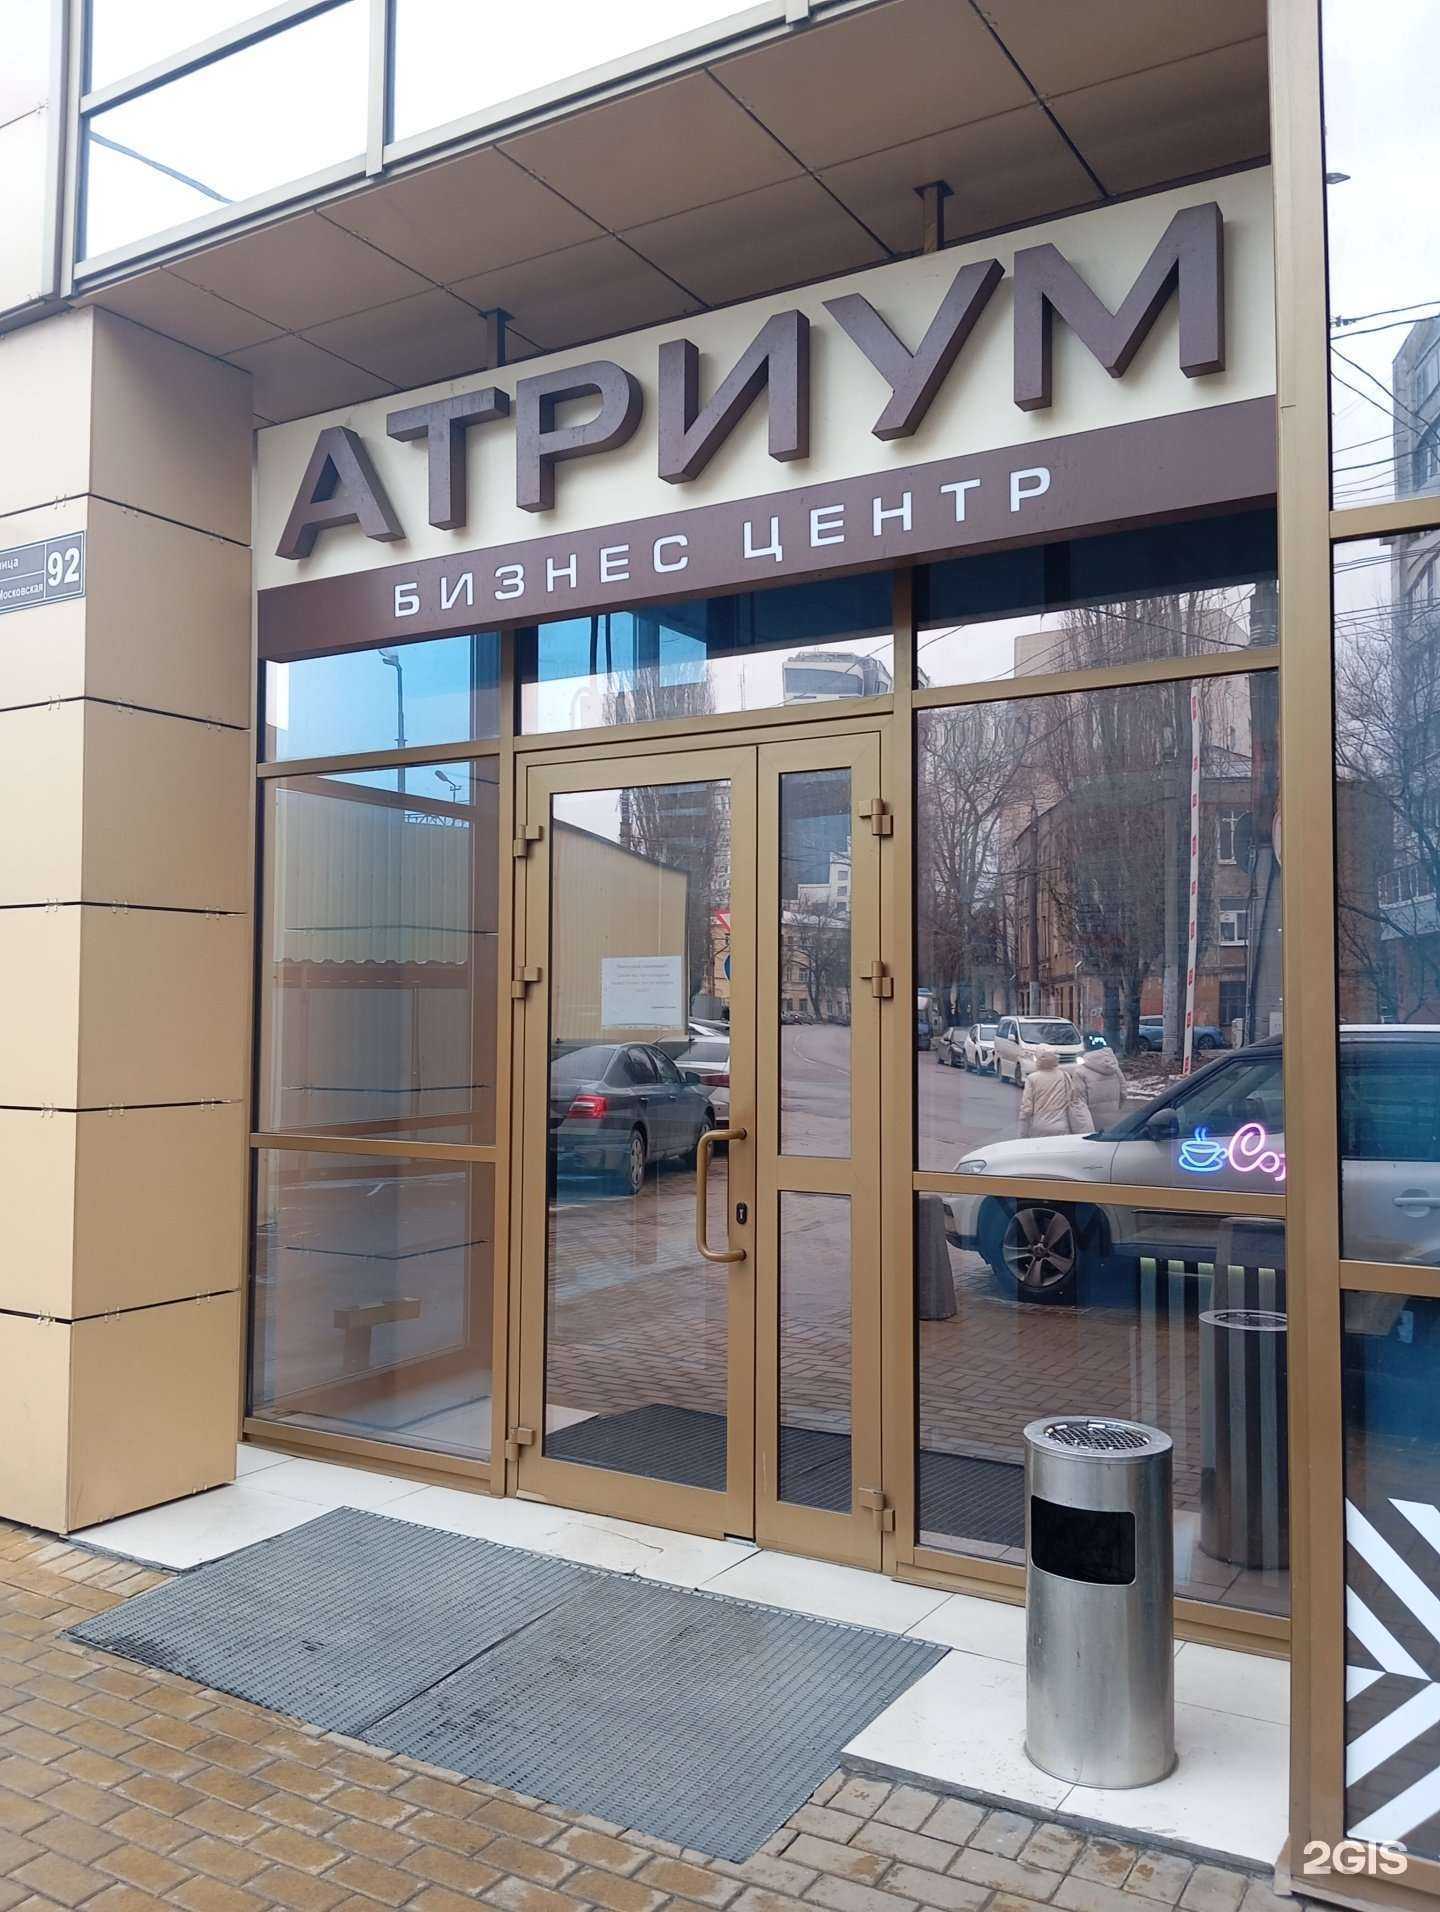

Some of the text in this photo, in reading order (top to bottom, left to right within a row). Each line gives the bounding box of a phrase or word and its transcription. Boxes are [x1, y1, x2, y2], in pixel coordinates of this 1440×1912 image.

[275, 201, 1226, 560] АТРИУМ
[47, 547, 80, 587] 92
[393, 466, 1052, 618] БИЗНЕС ЦЕНТР
